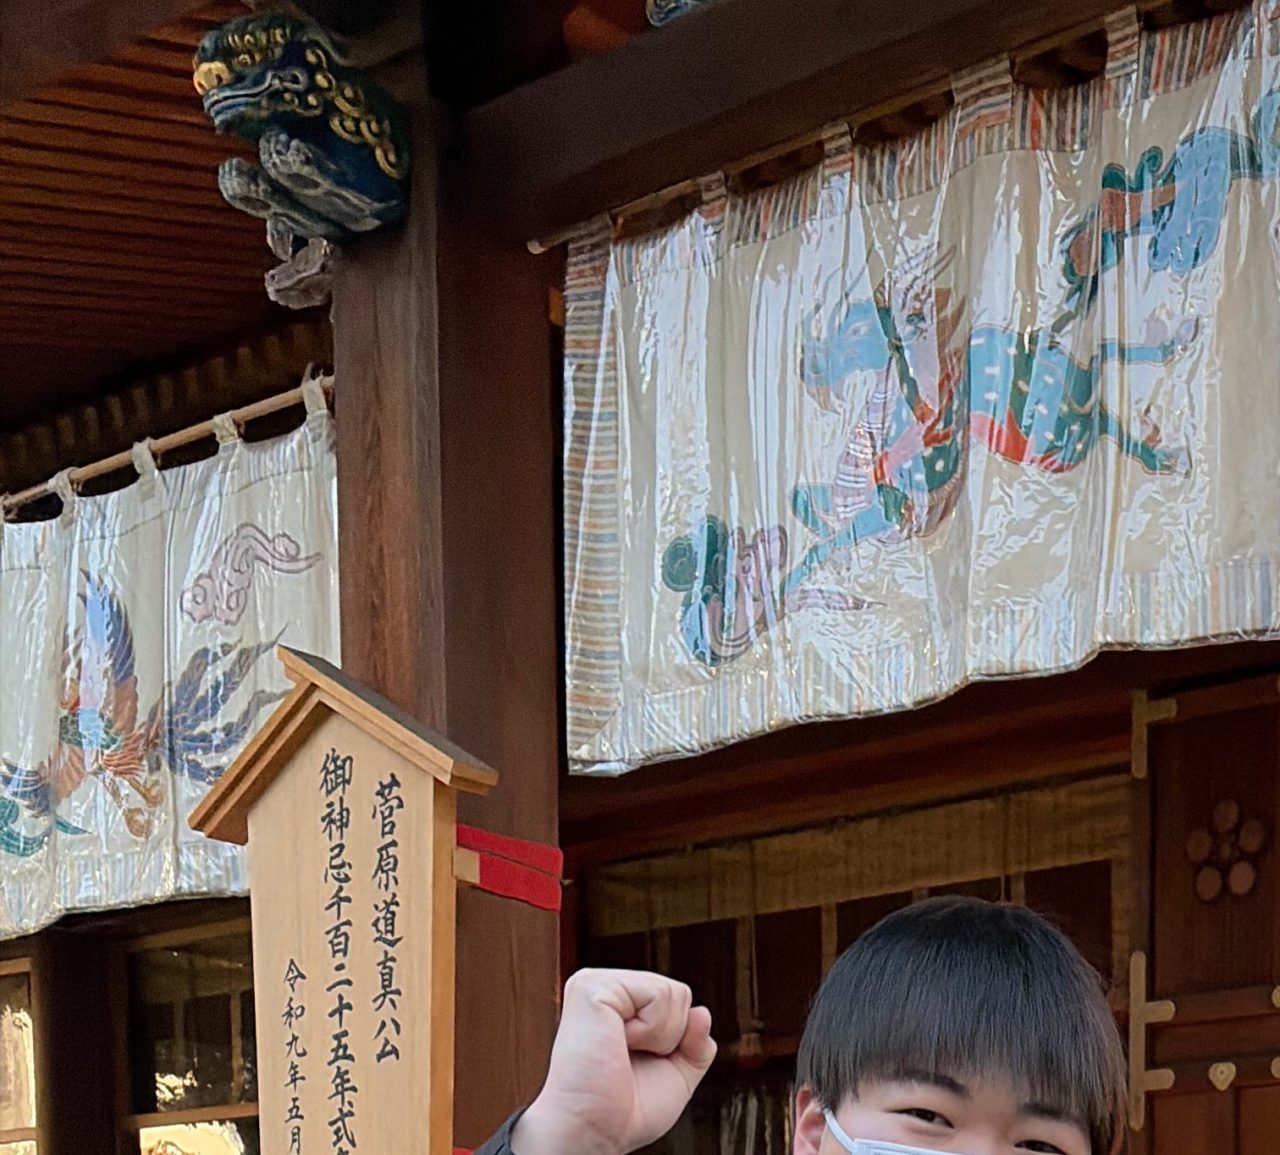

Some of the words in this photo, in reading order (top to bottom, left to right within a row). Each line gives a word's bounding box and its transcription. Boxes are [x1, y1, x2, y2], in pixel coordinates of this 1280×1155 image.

[371, 772, 405, 1063] 菅原道真公
